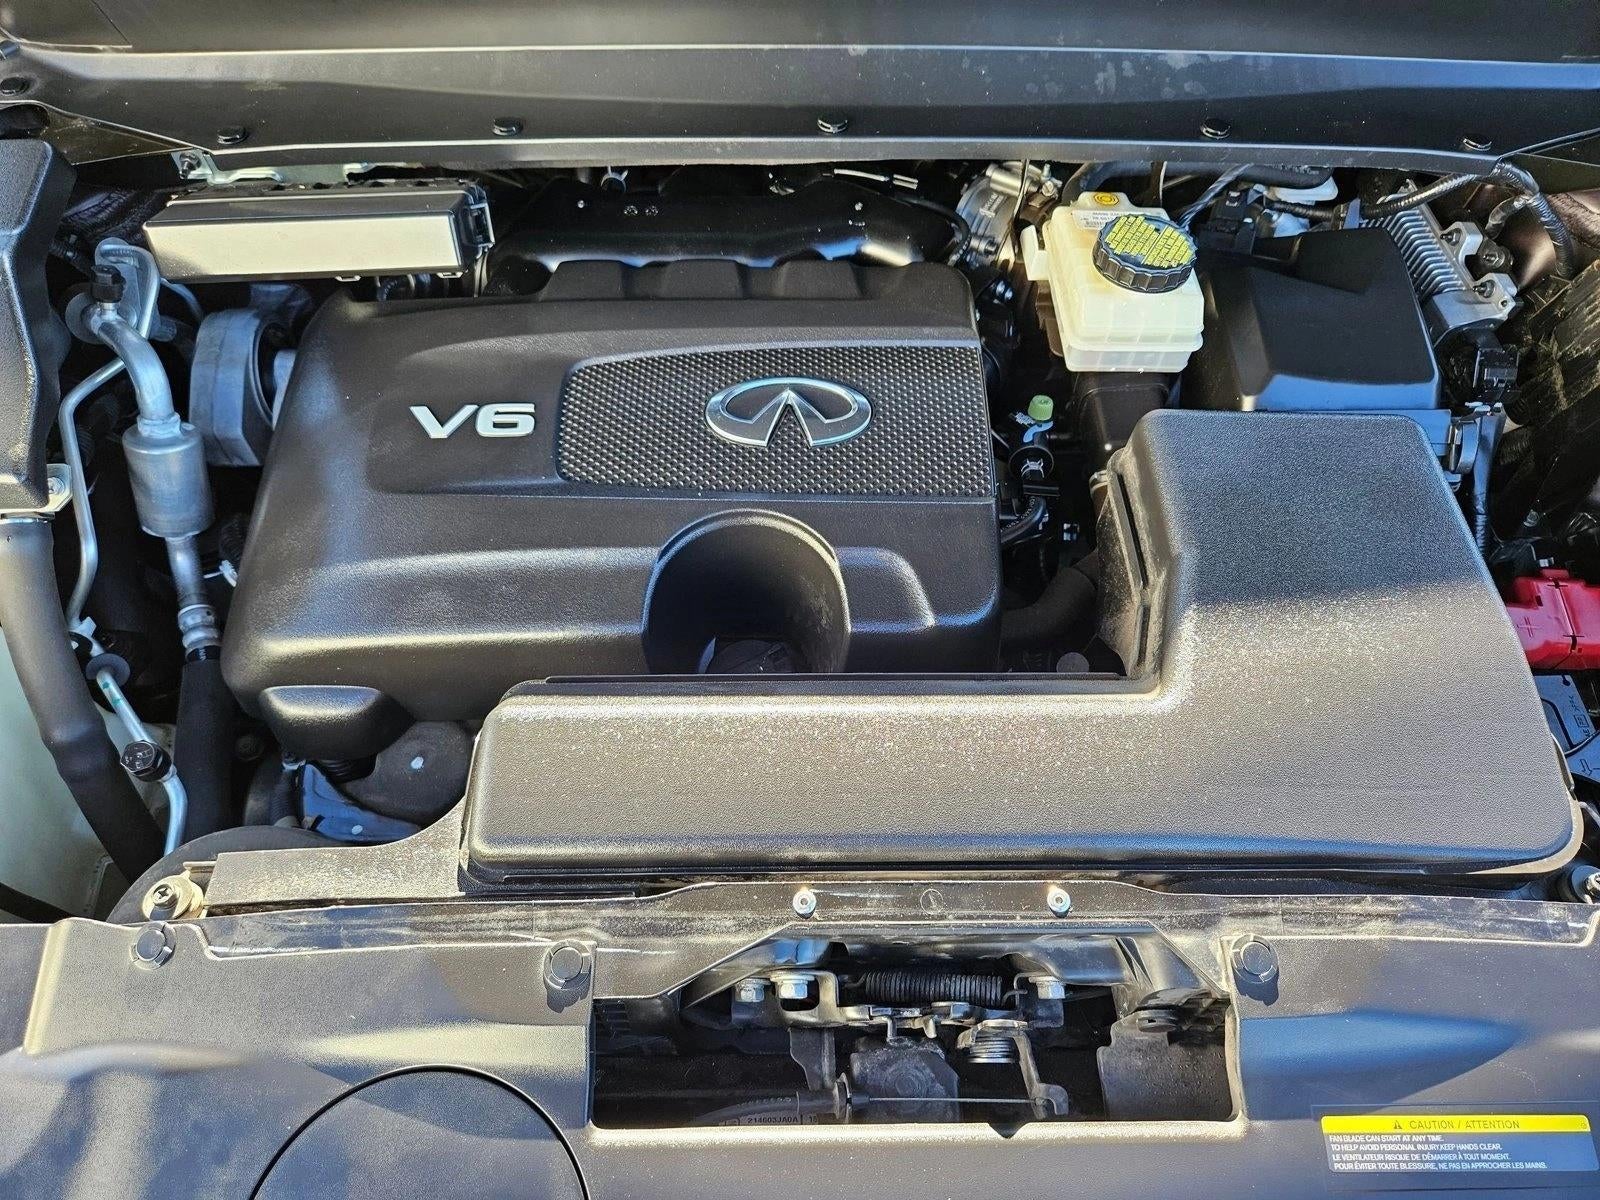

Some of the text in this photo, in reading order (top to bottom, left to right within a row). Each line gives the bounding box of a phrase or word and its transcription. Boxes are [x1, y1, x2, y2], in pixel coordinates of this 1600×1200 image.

[409, 403, 535, 438] V6
[1409, 1120, 1454, 1129] CAUTION
[1465, 1119, 1520, 1129] ATTENTION
[1422, 1152, 1456, 1160] DÉMARRER
[1354, 1161, 1376, 1170] ÉVITER
